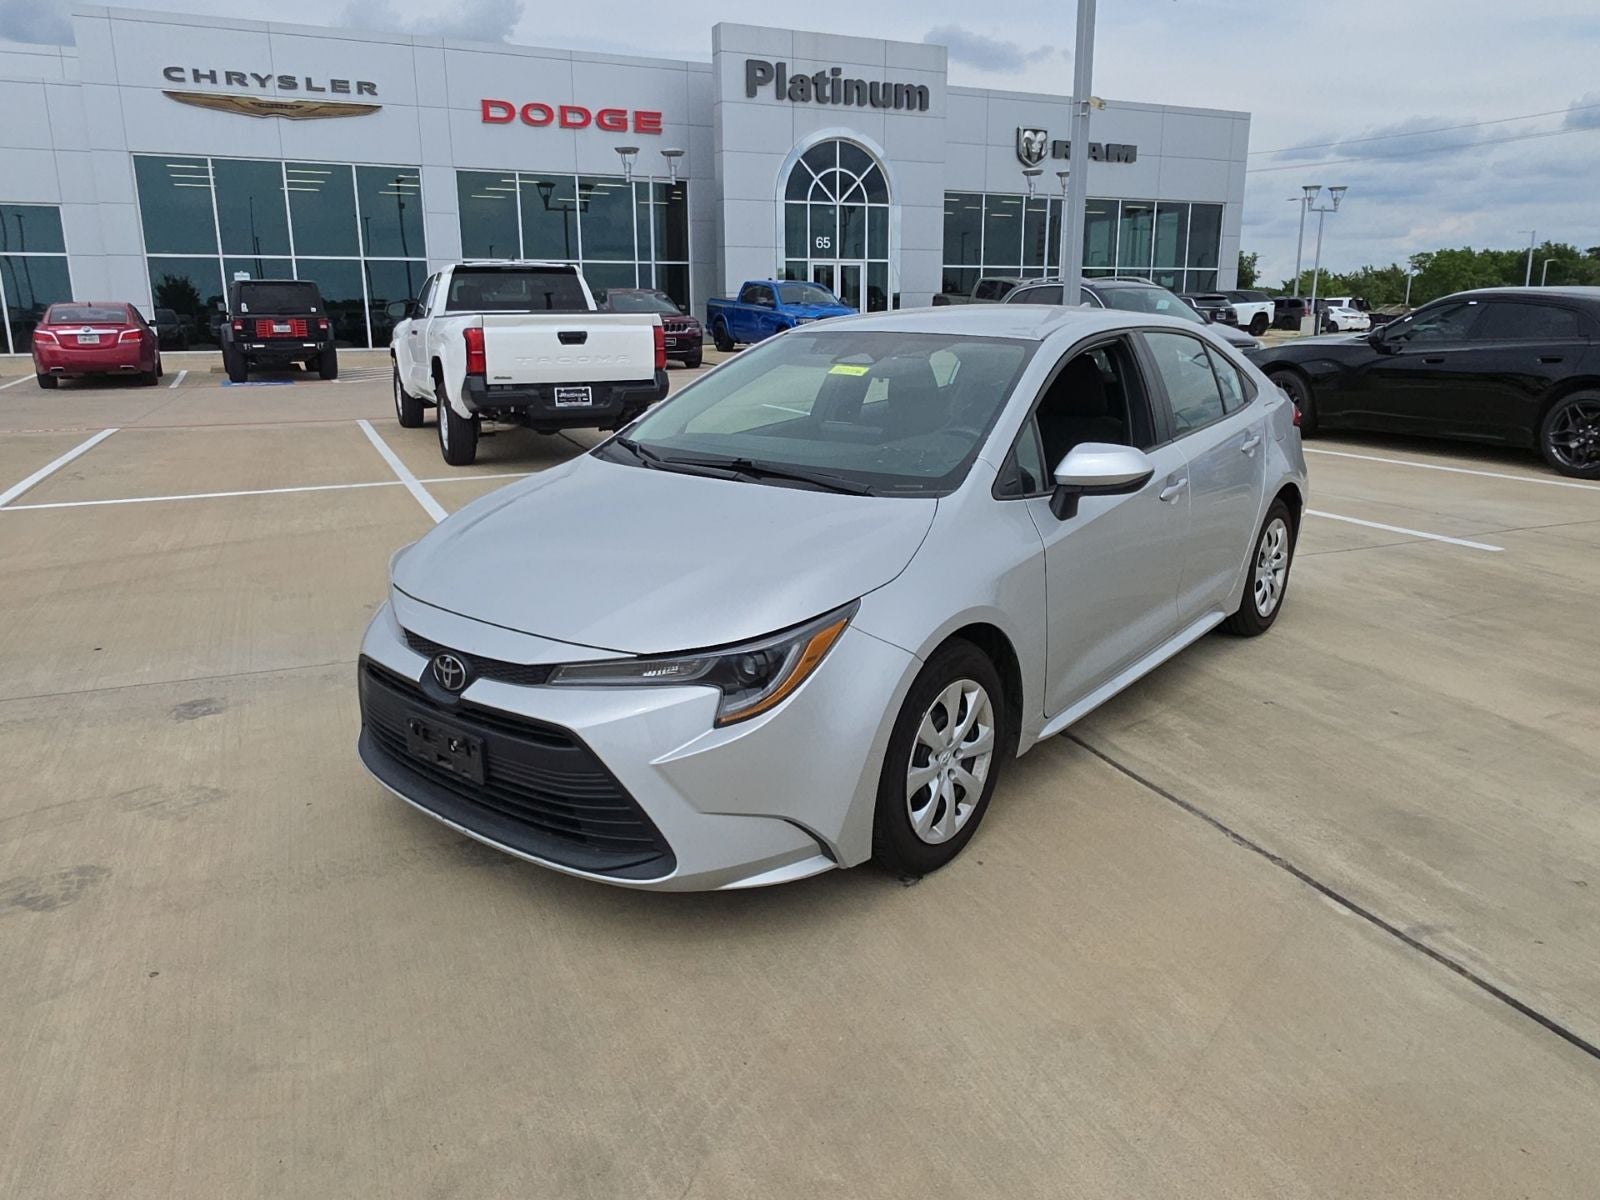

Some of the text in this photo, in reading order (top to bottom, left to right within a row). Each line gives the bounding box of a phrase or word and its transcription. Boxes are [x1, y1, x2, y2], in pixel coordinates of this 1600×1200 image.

[162, 66, 379, 96] CHRYSLER
[745, 58, 930, 112] Platinum
[481, 98, 663, 135] DODGE
[1051, 139, 1138, 164] RAM
[815, 236, 831, 249] 65
[514, 354, 632, 366] TACOMA
